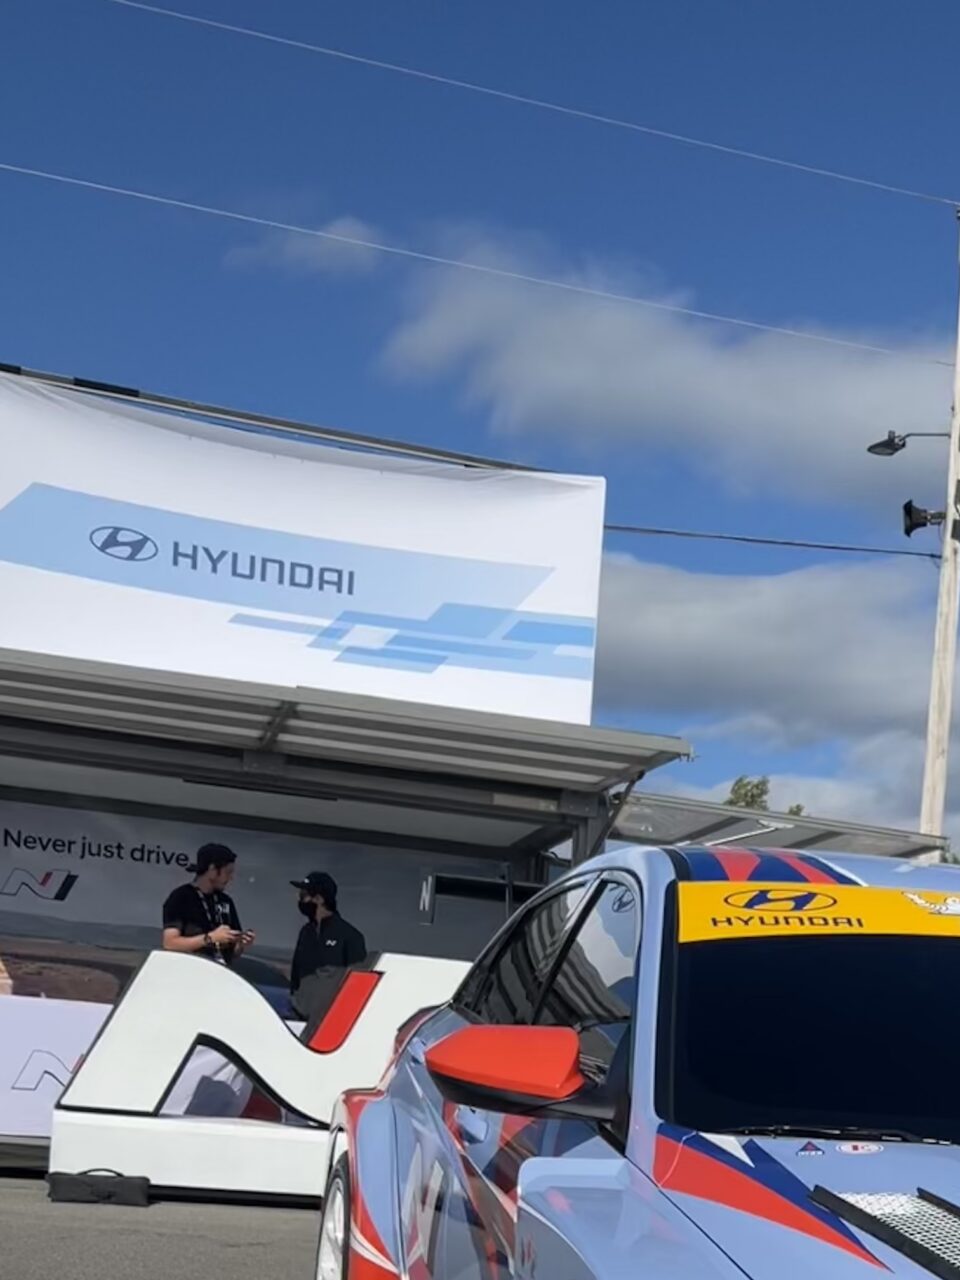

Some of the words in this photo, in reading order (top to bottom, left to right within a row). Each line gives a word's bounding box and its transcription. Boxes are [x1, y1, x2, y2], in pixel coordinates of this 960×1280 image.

[172, 540, 356, 596] HYUNDAI
[3, 828, 77, 854] Never
[80, 836, 124, 859] just
[711, 916, 864, 928] HYUNDAI
